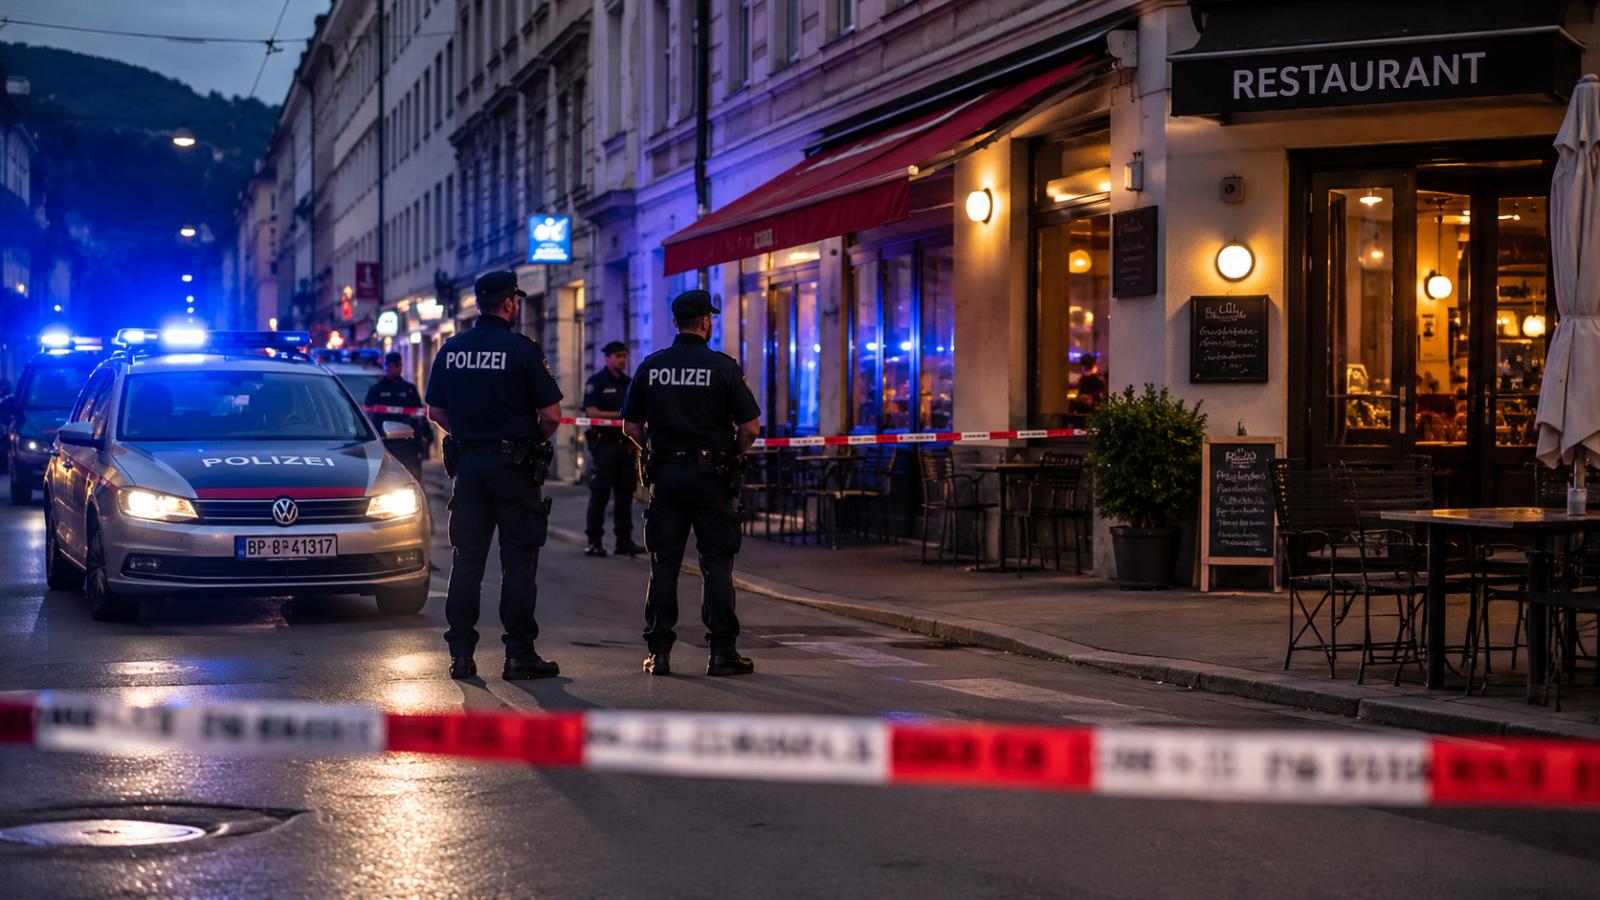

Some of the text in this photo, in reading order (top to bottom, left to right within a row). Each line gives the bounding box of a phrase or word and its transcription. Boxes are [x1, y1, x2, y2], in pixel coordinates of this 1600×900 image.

[1233, 52, 1486, 100] RESTAURANT
[446, 351, 507, 370] POLIZEI
[648, 368, 711, 386] POLIZEI
[202, 456, 335, 467] POLIZEI
